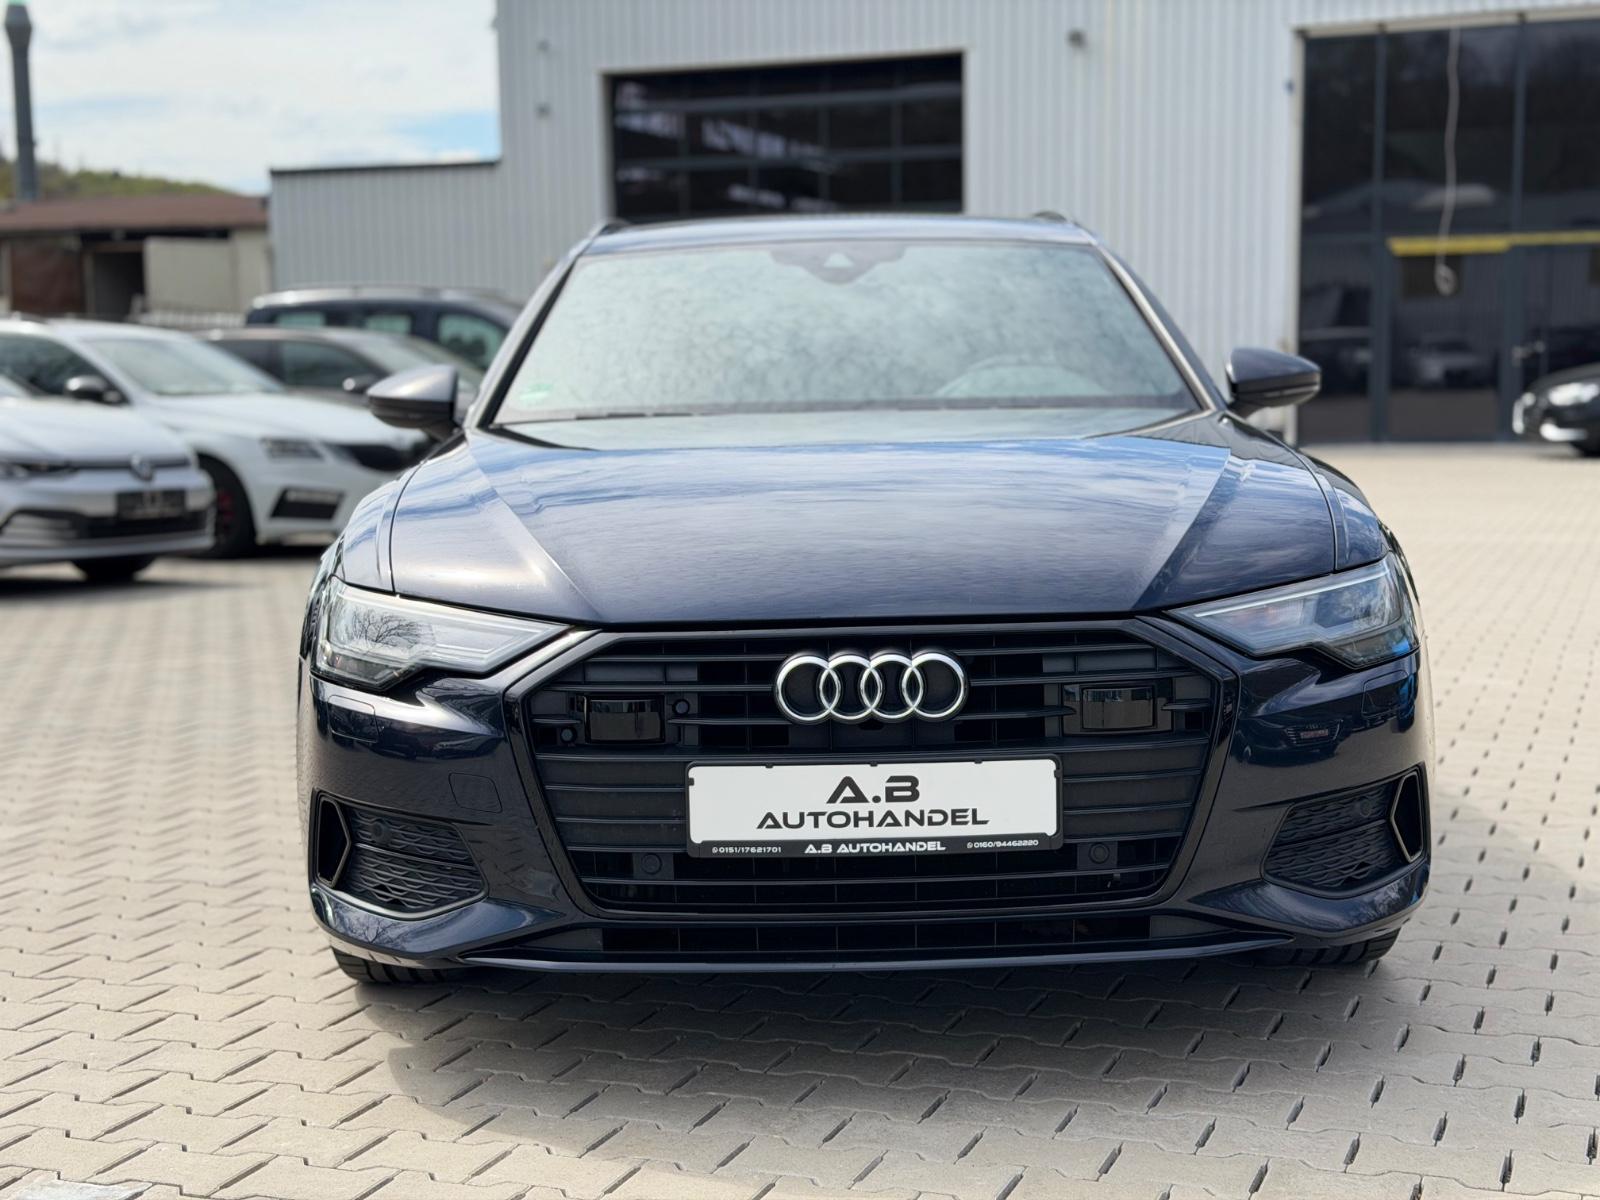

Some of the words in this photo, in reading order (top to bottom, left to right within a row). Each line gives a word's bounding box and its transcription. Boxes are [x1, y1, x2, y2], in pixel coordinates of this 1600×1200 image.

[827, 775, 920, 804] A.B
[757, 808, 990, 830] AUTOHANDEL
[718, 846, 782, 854] 0151/17621701
[804, 843, 833, 854] A.B
[837, 841, 946, 854] AUTOHANDEL
